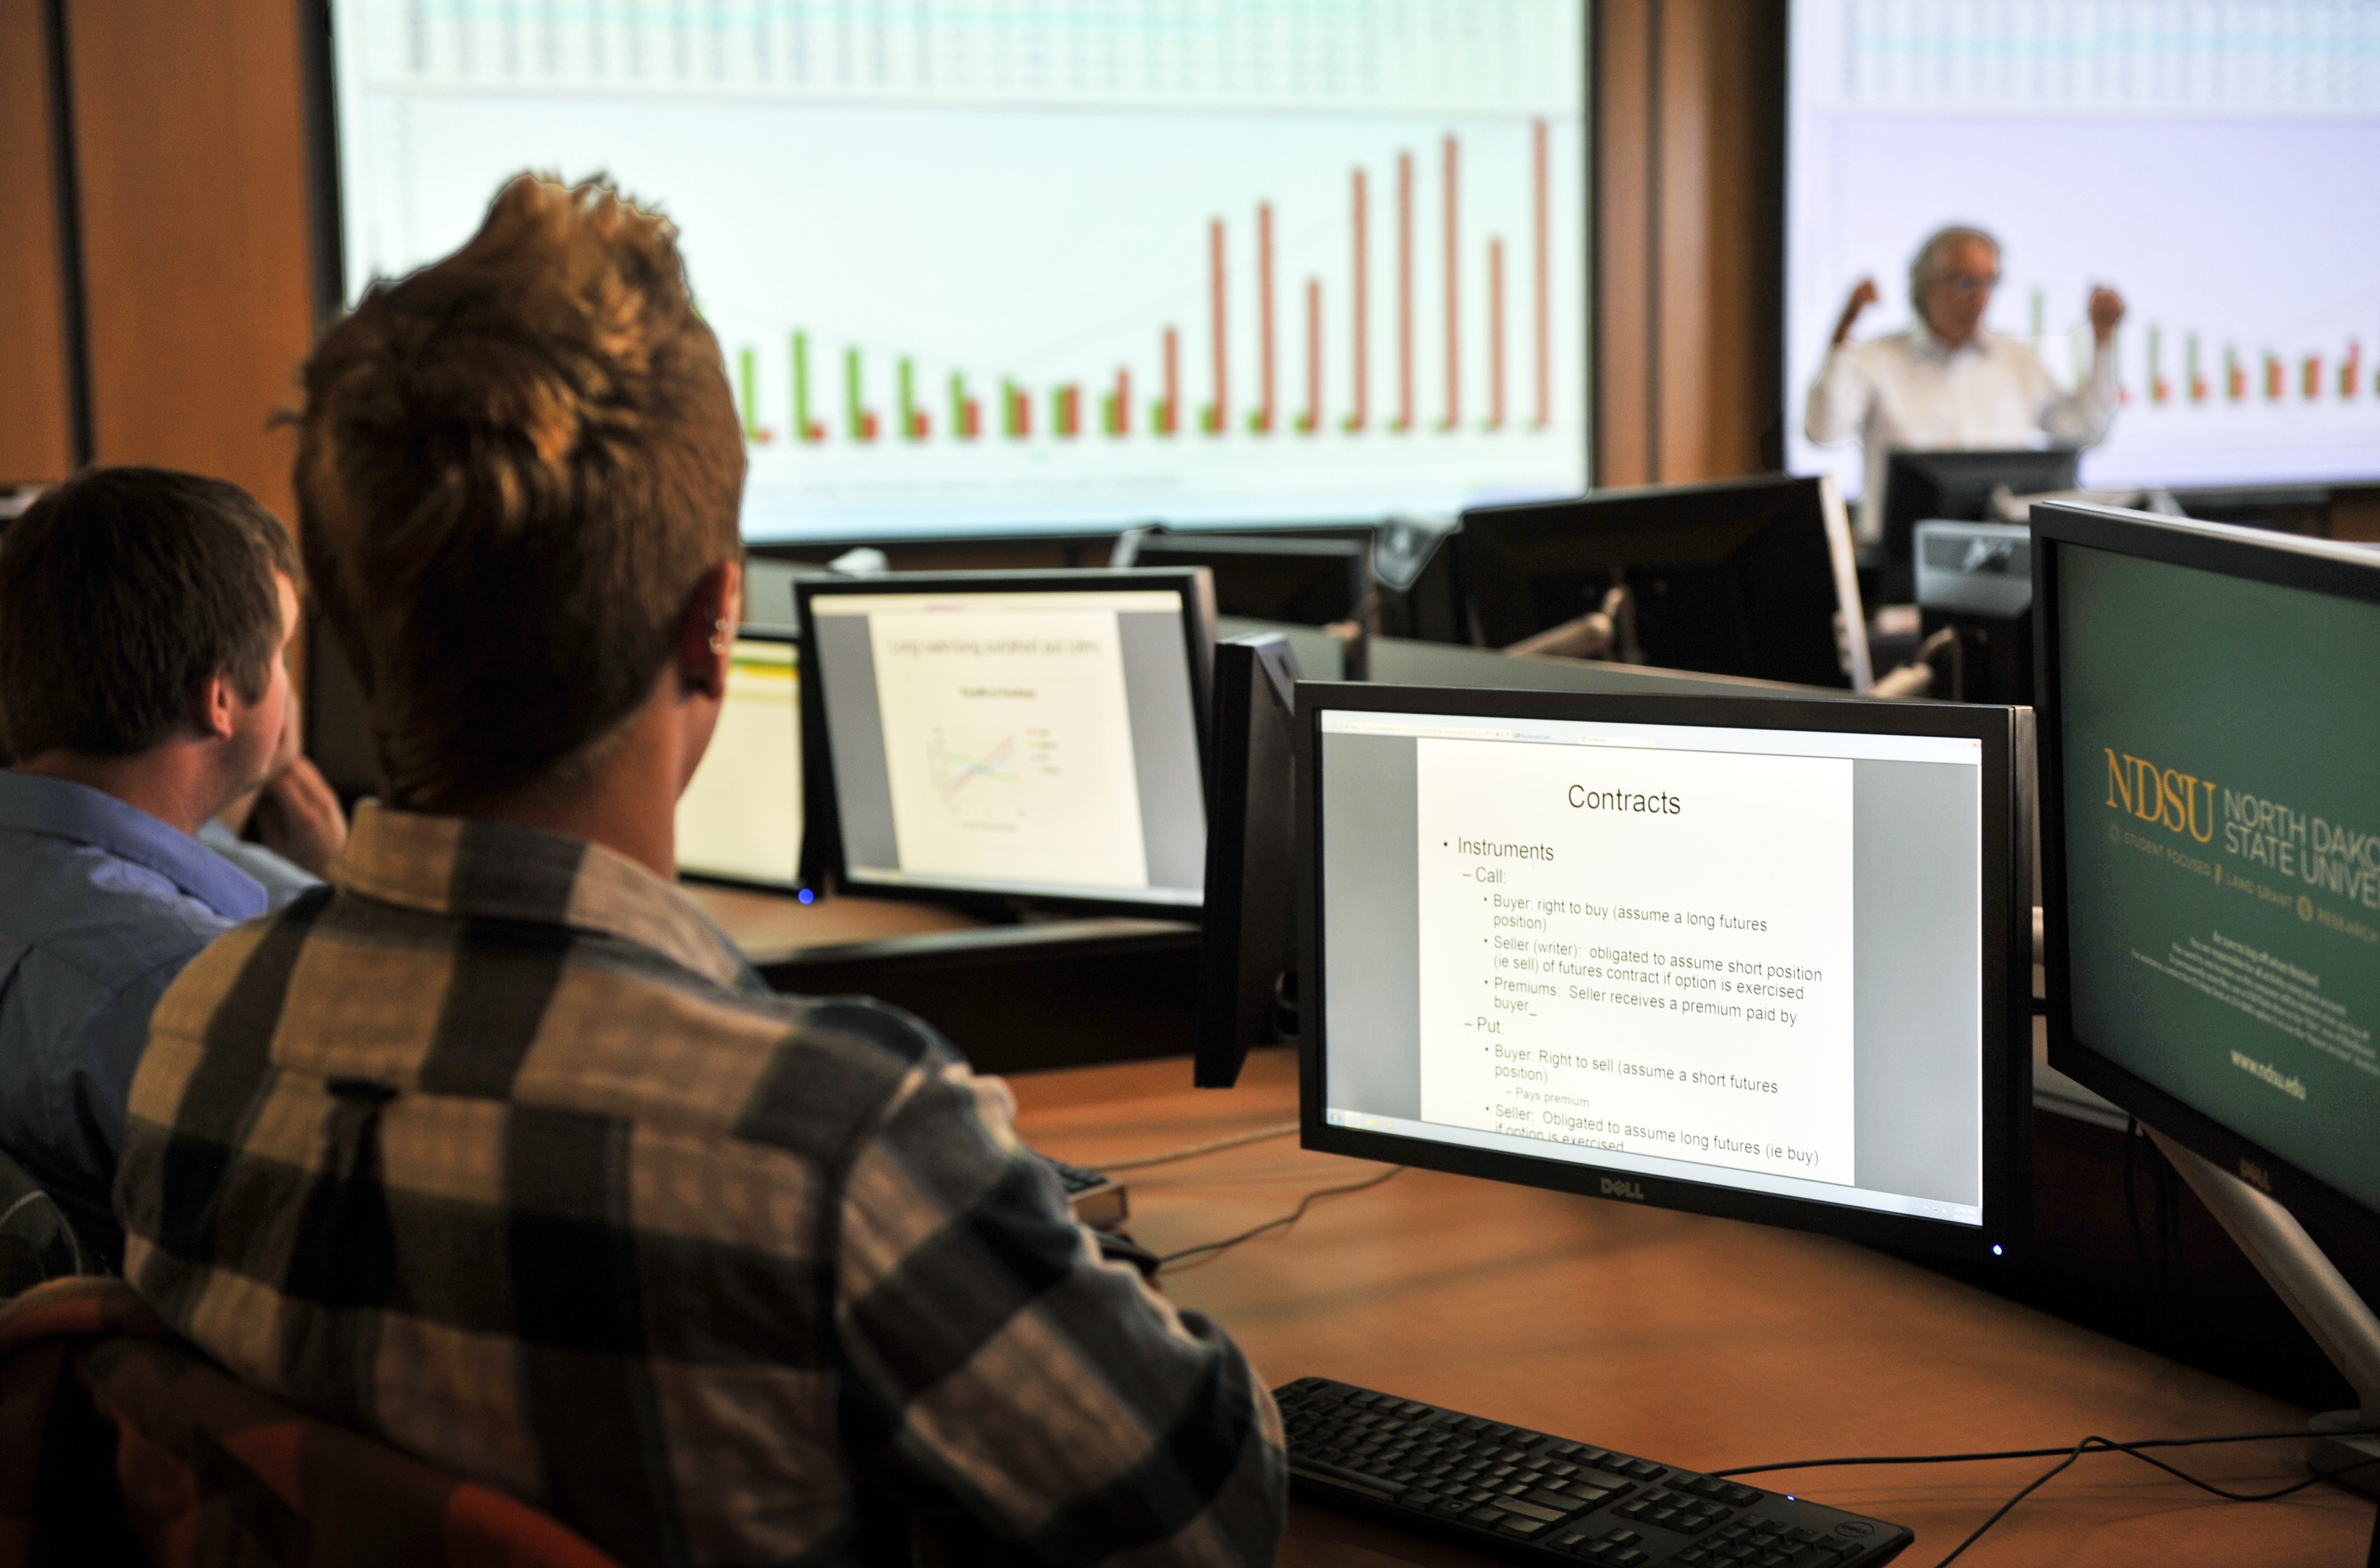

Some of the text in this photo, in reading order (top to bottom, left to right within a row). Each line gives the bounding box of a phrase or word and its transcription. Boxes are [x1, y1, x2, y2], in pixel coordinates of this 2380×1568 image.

[1568, 784, 1681, 815] Contracts
[2104, 747, 2216, 843] NDSU
[2223, 787, 2307, 846] NORTH
[1458, 836, 1554, 861] Instruments
[2225, 821, 2295, 878] STATE
[1475, 867, 1506, 884] Call:
[1494, 893, 1768, 932] Buyer: right to buy (assume a long futures
[1494, 915, 1546, 933] position)
[1494, 935, 1822, 982] Seller (writer): obligated to assume short position
[1494, 954, 1804, 999] (ie sell) of futures contract if option is exercised
[1494, 977, 1797, 1027] Premiums: Seller receives a premium paid by
[1477, 1016, 1503, 1034] Put:
[1495, 1044, 1778, 1093] Buyer: Right to sell (assume a short futures
[1495, 1065, 1548, 1085] position)
[1516, 1087, 1589, 1107] Pays premium
[1495, 1104, 1819, 1167] Seller: Obligated to assume long futures (ie buy)
[1600, 1177, 1645, 1201] DELL
